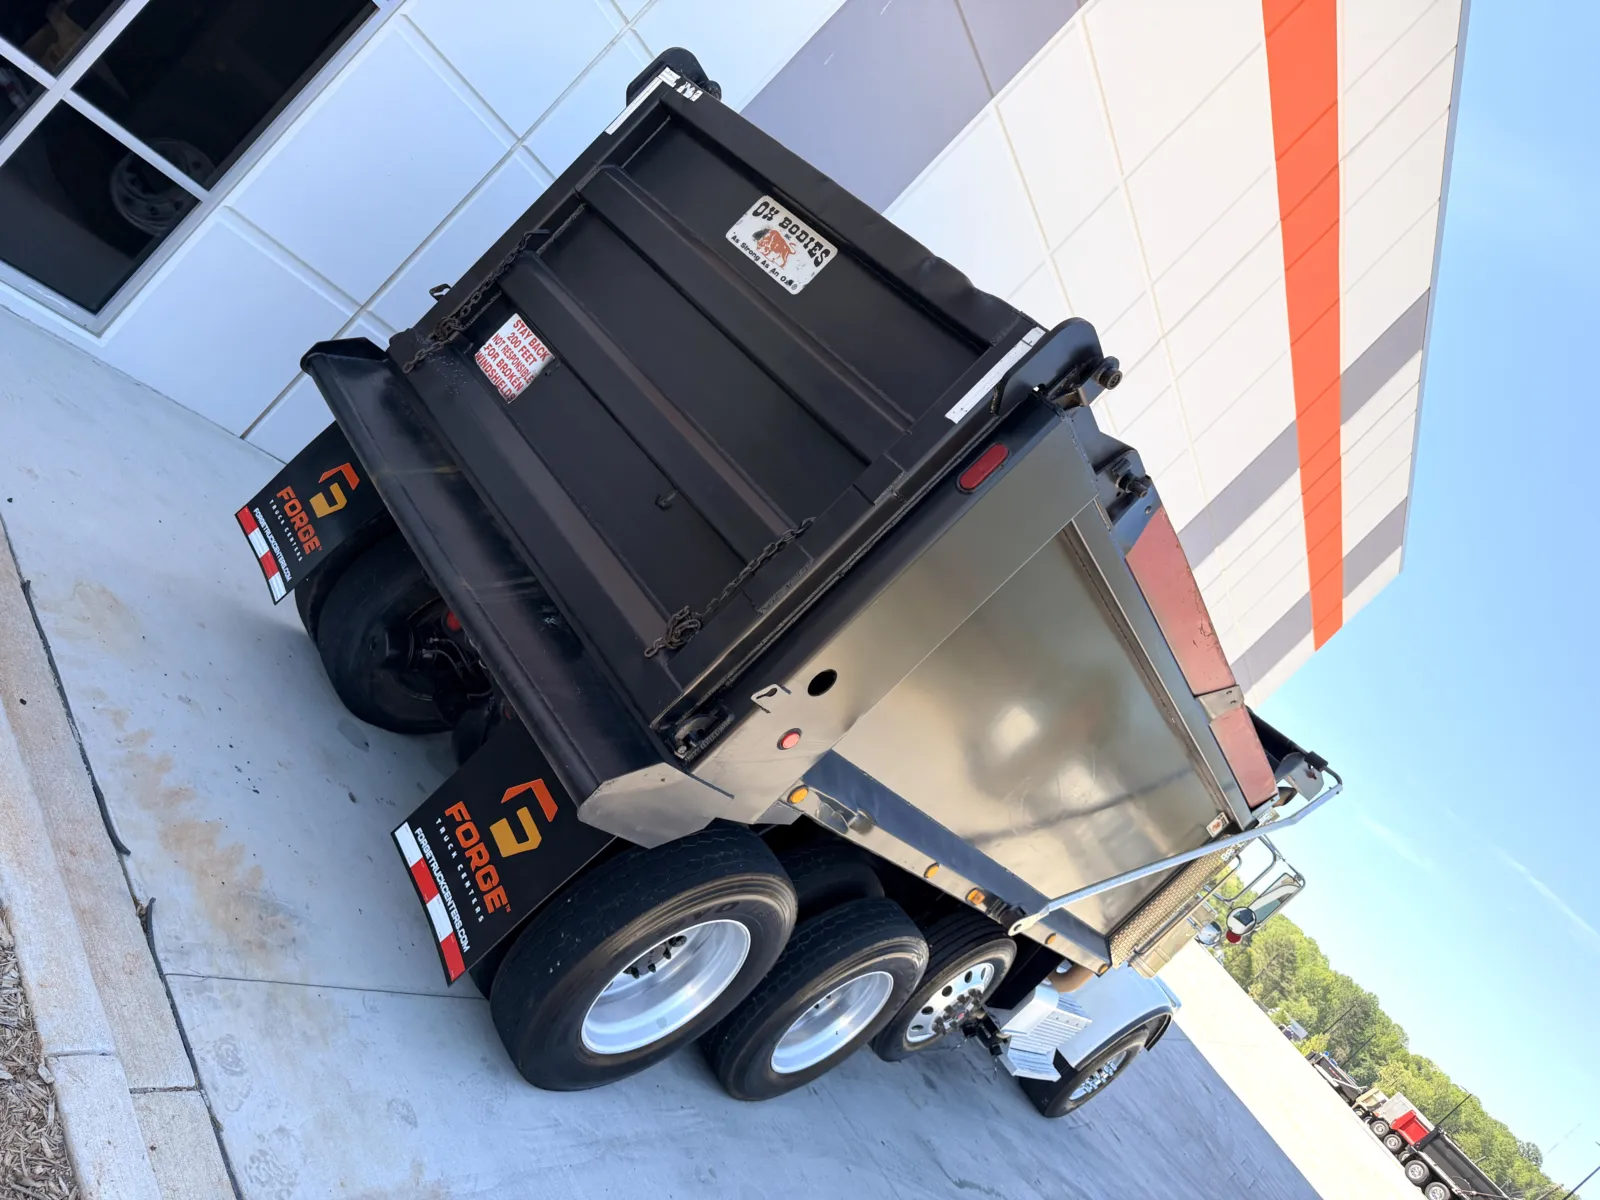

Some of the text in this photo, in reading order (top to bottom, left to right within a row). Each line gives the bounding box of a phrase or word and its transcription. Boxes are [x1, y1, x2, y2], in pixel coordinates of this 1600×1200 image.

[731, 235, 740, 244] As
[740, 242, 761, 262] Strong
[761, 259, 770, 269] As
[770, 267, 780, 277] An
[752, 201, 831, 268] OX BODIES
[483, 343, 524, 392] FOR BROKEN
[491, 333, 534, 384] NOT RESPONSIBLE
[506, 332, 537, 366] 200 FEET
[512, 319, 551, 361] STAY BACK
[269, 499, 303, 562] TRUCK CENTERS
[276, 485, 321, 555] FORGE
[435, 818, 485, 923] TRUCK CENTERS
[444, 801, 509, 914] FORGE
[414, 827, 471, 953] FORGETRUCKCENTERS.COM
